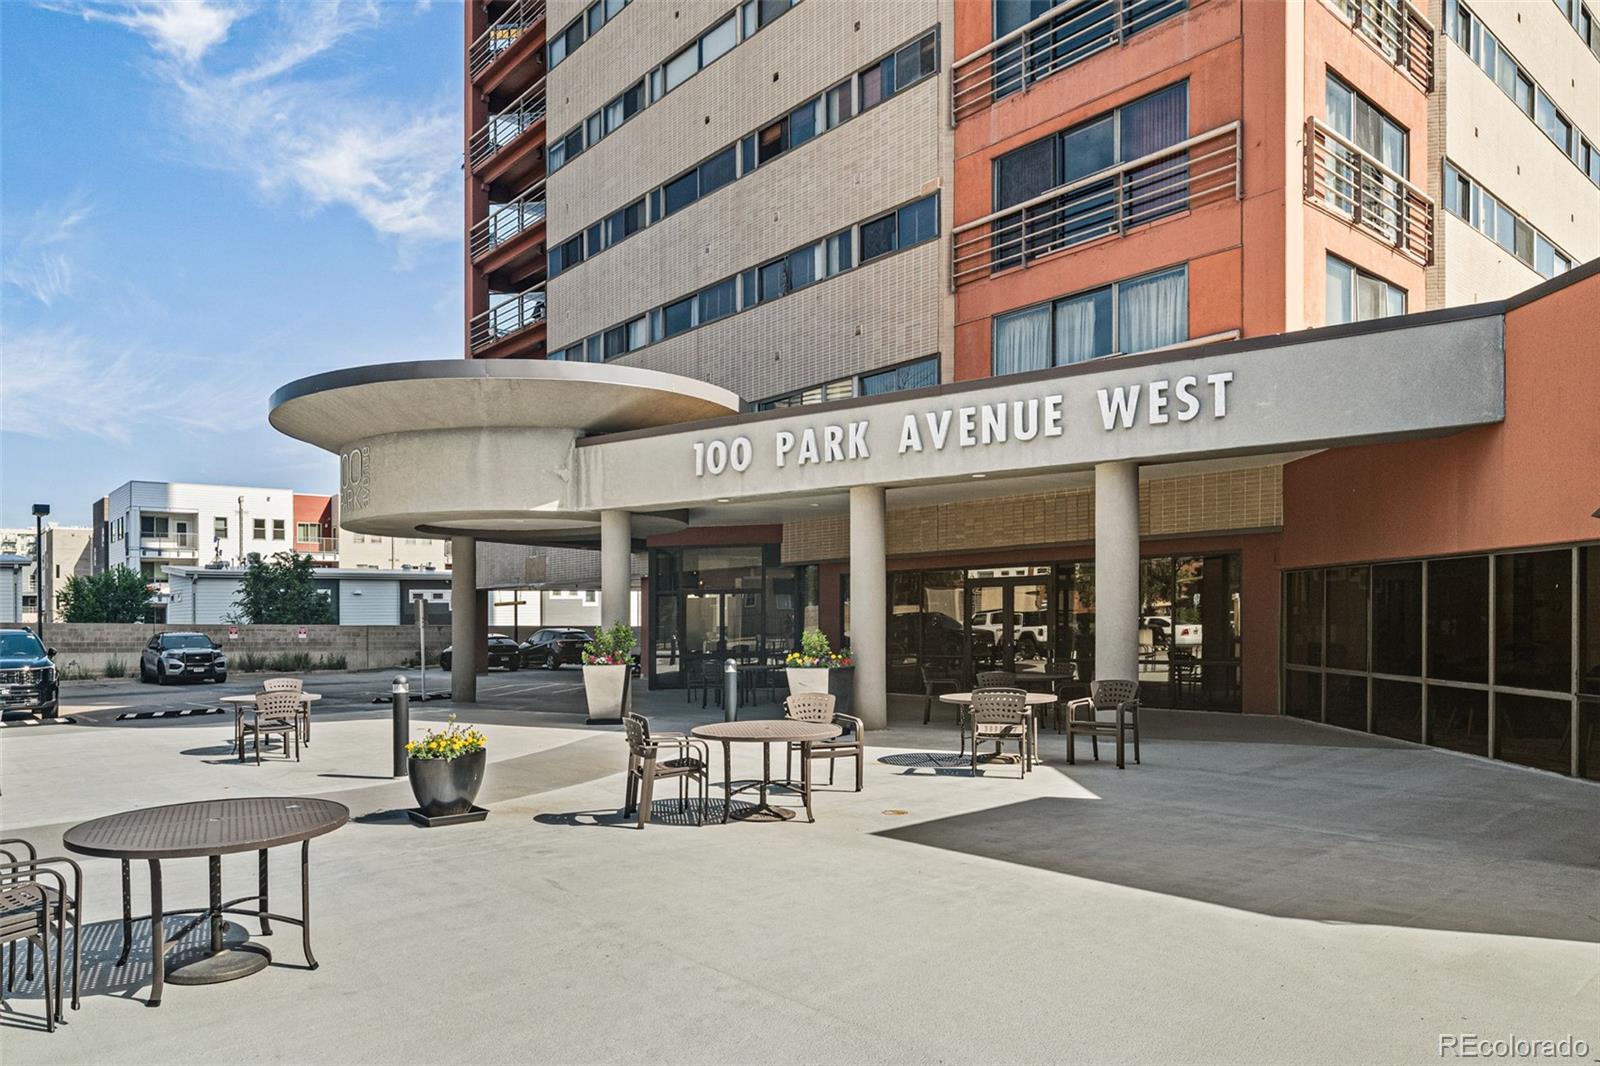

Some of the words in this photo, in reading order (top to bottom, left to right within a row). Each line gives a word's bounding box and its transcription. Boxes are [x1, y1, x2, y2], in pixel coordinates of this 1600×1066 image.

[693, 436, 753, 477] 100
[775, 420, 870, 467] PARK
[899, 395, 1064, 454] AVENUE
[1097, 371, 1234, 431] WEST
